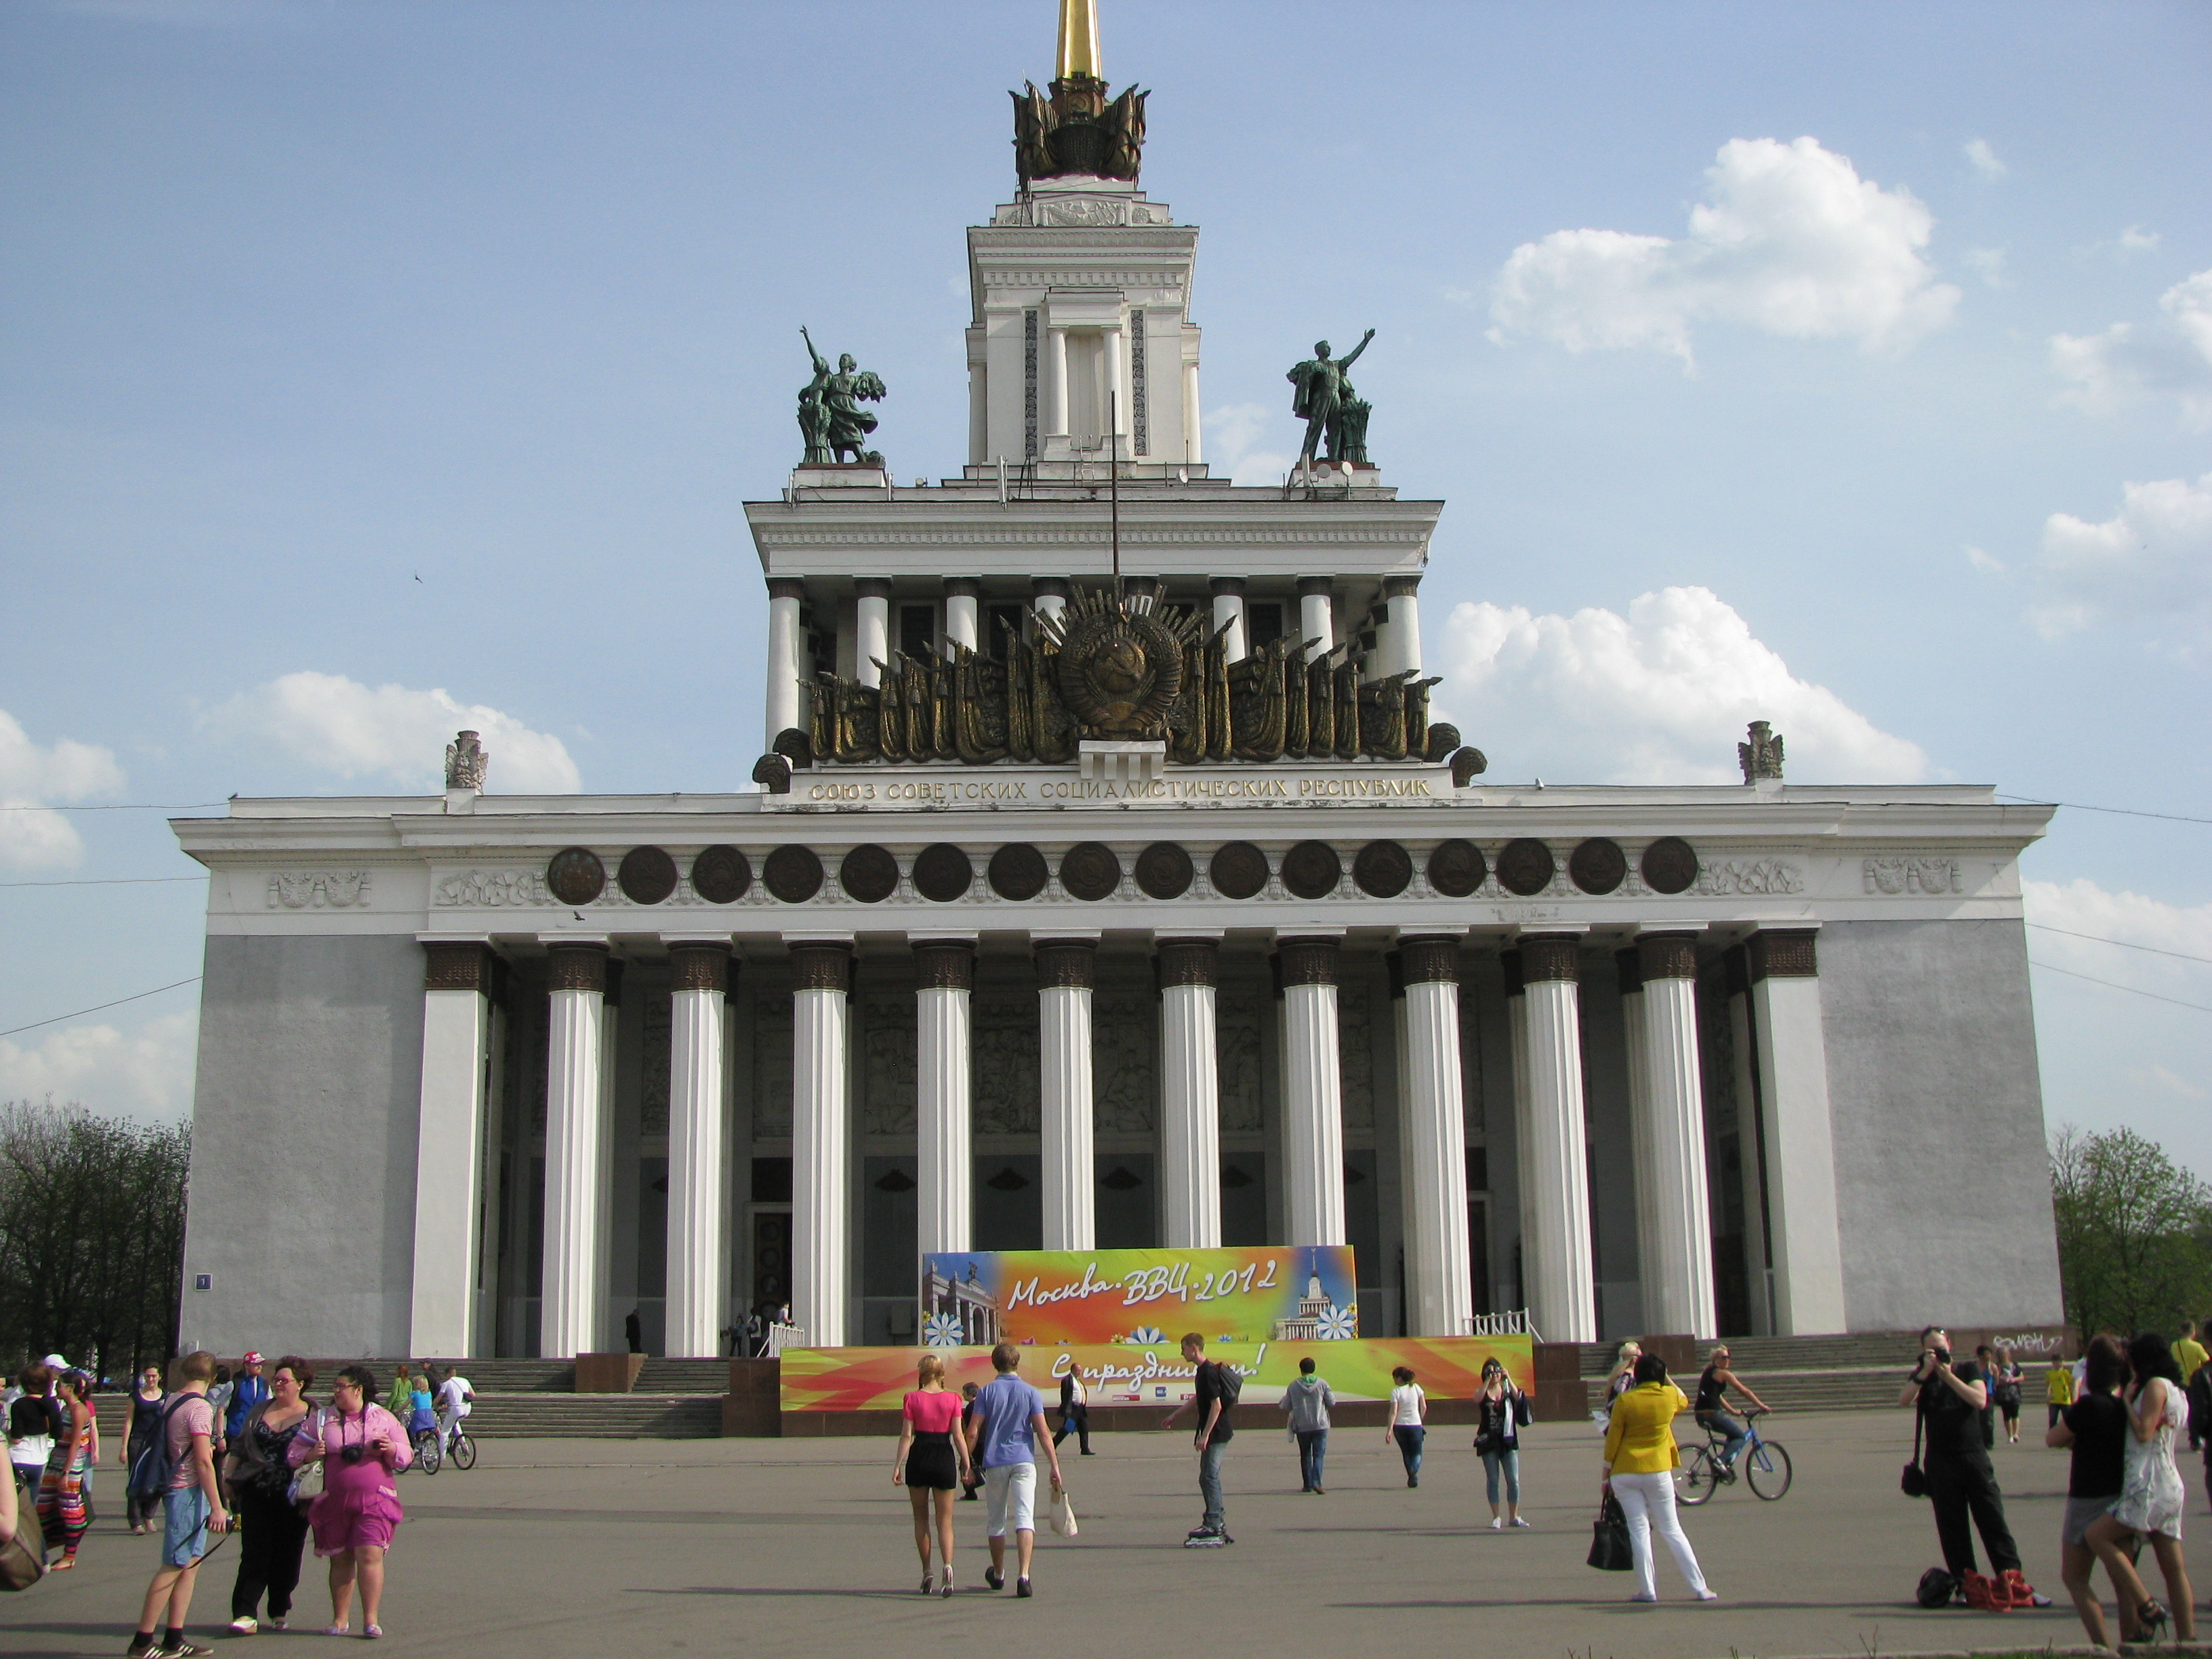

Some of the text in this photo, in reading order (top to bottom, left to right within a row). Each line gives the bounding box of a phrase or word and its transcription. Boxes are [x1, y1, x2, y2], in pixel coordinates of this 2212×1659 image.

[811, 779, 1431, 800] СОЮЗ СОВЕТСКИХ СОЦИАЛИСТИЧЕСКИХ РЕСПУБЛИК
[1051, 1343, 1266, 1392] С праздним!
